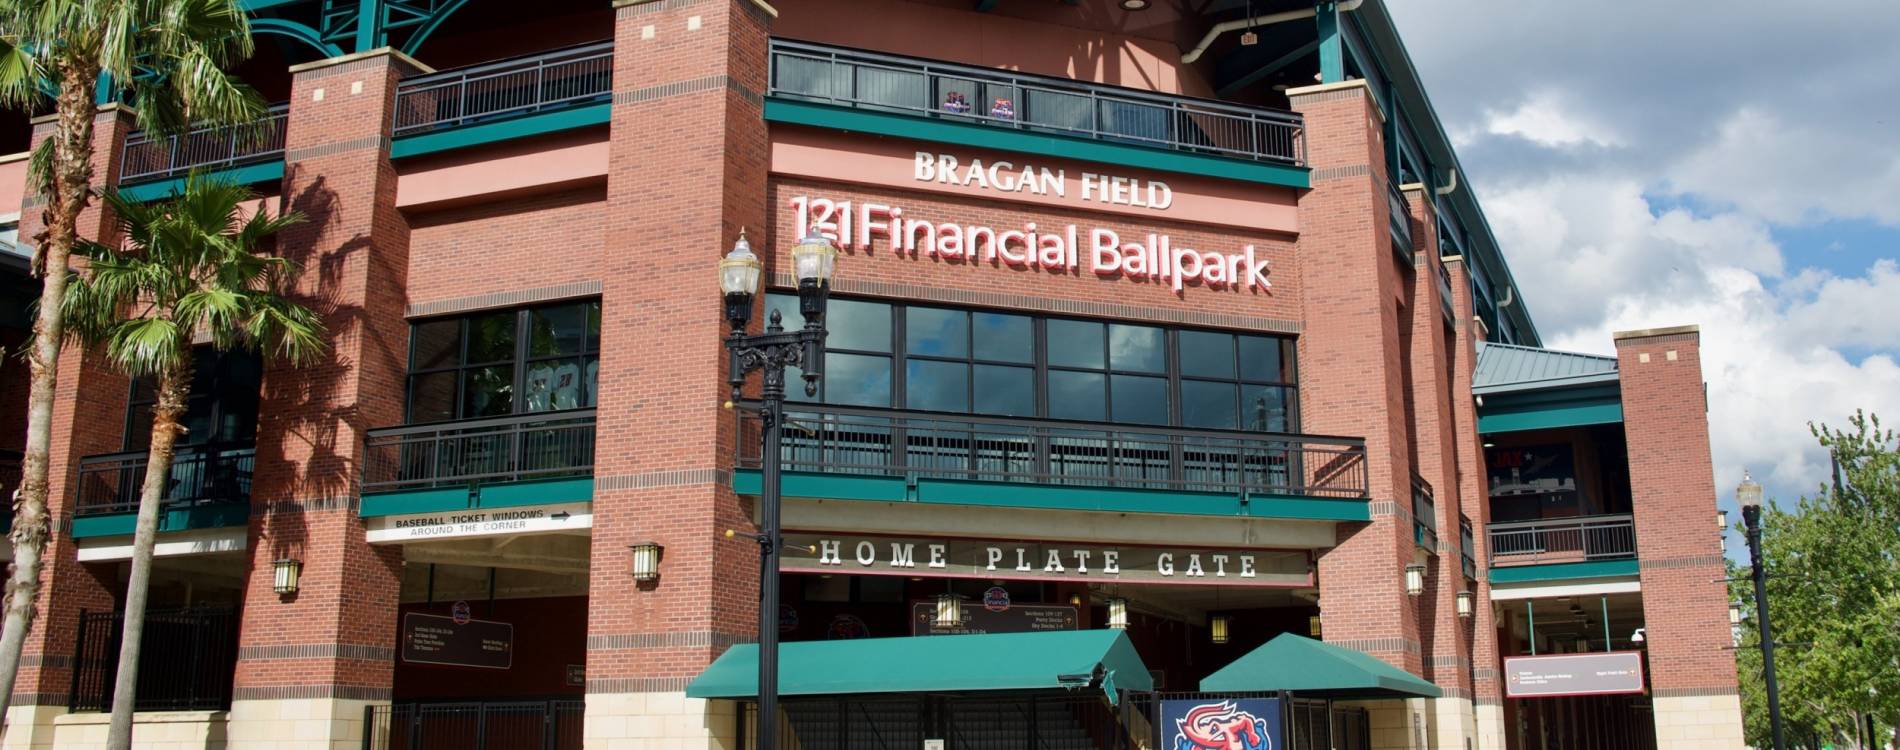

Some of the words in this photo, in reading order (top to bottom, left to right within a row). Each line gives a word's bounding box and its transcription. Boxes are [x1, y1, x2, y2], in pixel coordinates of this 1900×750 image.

[914, 151, 1065, 198] BRAGAN
[1081, 172, 1172, 210] FIELD
[790, 196, 851, 246] 121
[859, 203, 1077, 269] Financial
[1090, 228, 1272, 293] Ballpark
[396, 517, 445, 528] BASEBALL
[450, 514, 486, 524] TICKET
[492, 509, 544, 521] WINDOWS
[410, 525, 453, 536] AROUND
[460, 524, 478, 532] THE
[484, 521, 526, 531] CORNER
[819, 540, 946, 569] HOME
[986, 547, 1120, 574] PLATE
[1157, 553, 1256, 578] GATE
